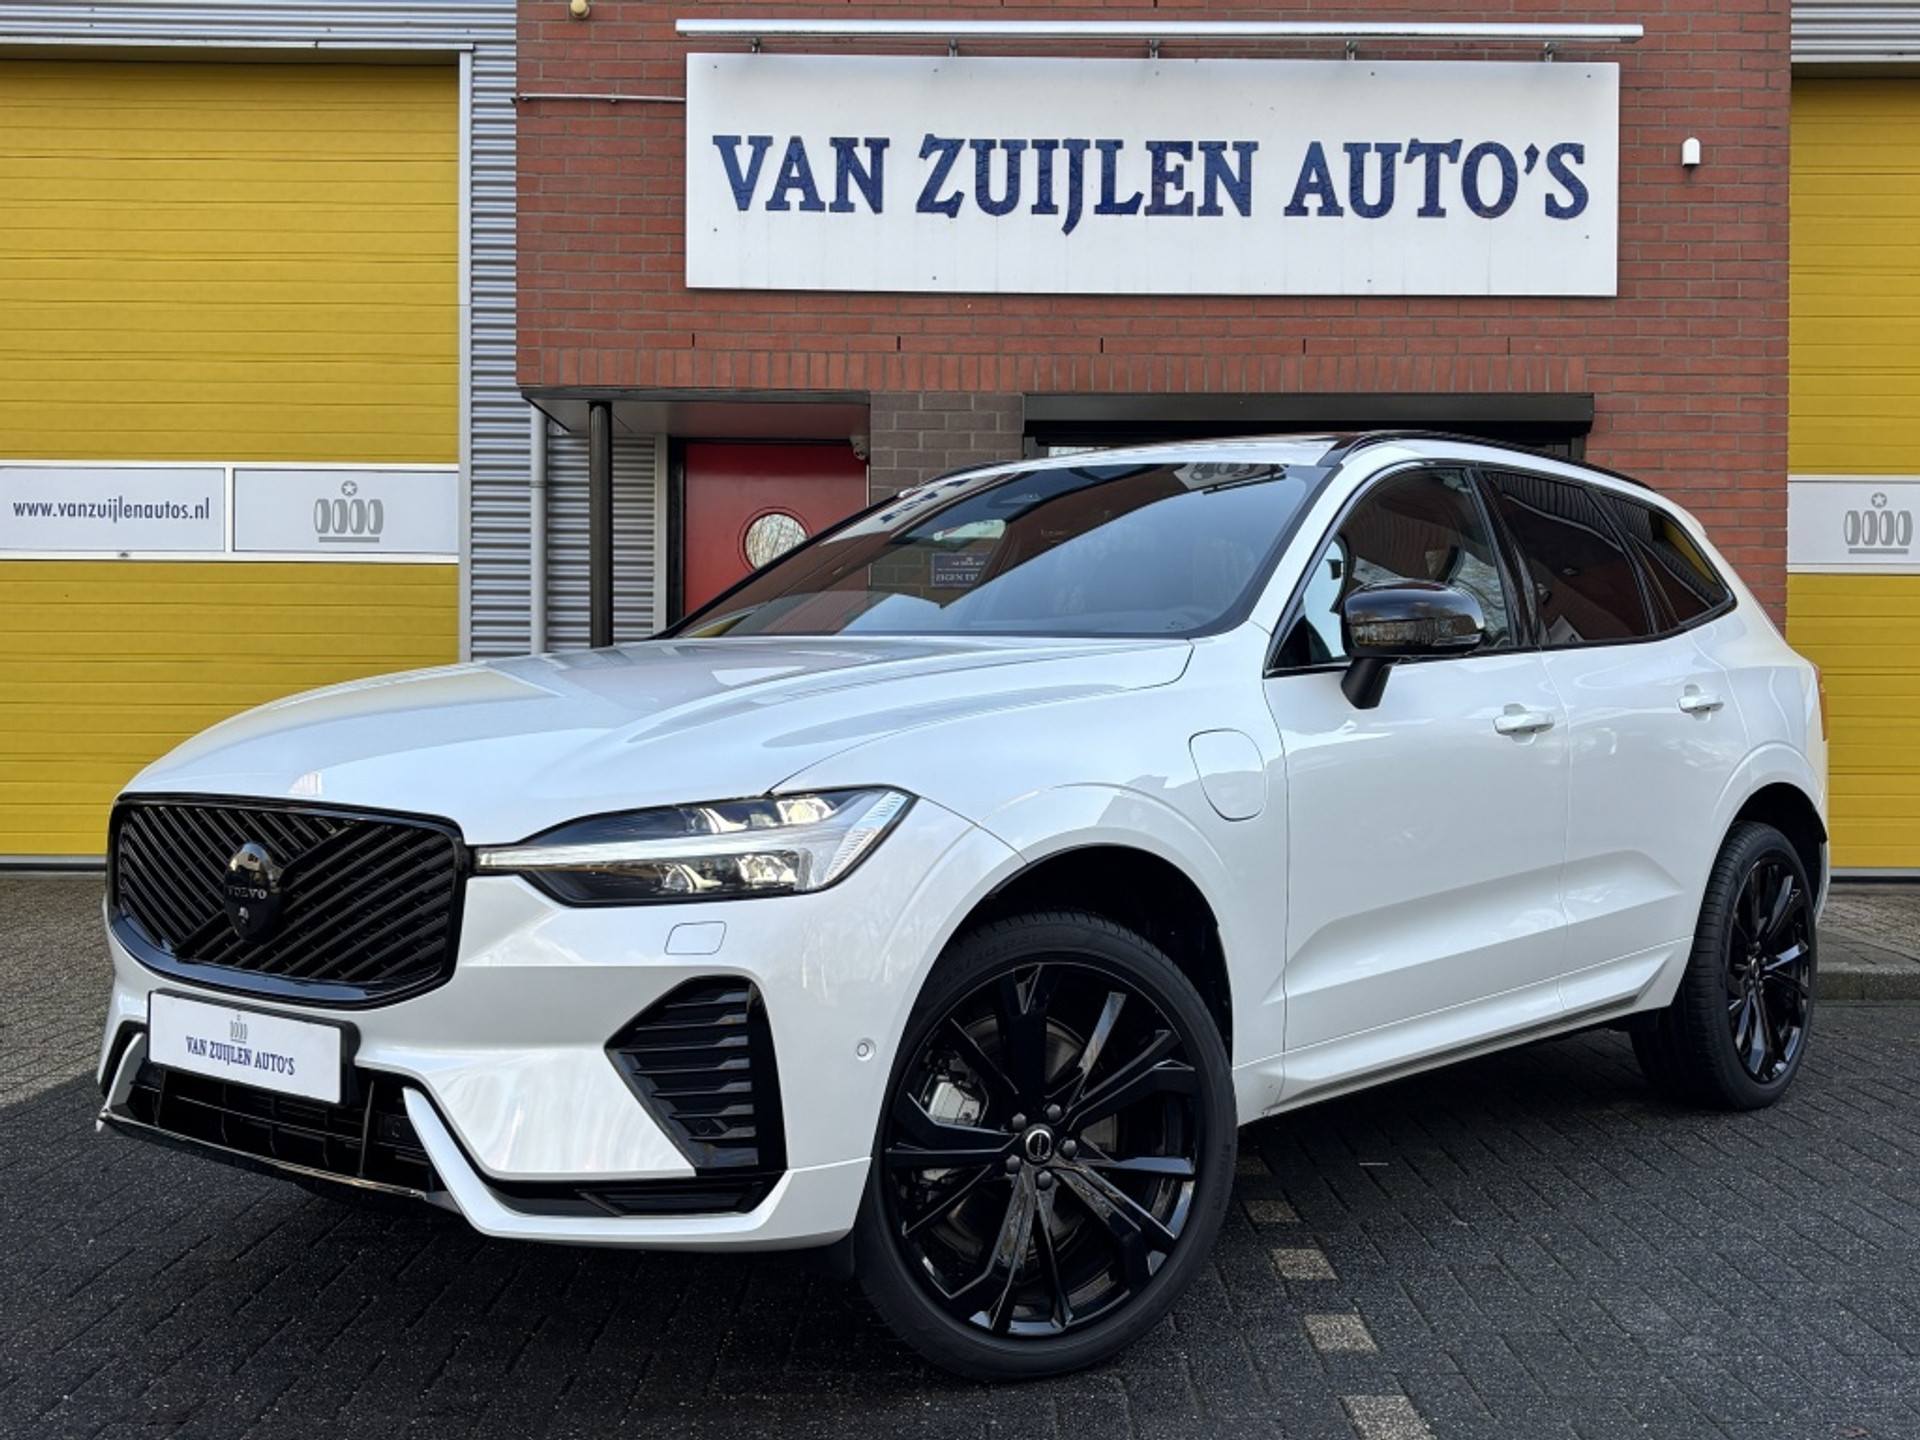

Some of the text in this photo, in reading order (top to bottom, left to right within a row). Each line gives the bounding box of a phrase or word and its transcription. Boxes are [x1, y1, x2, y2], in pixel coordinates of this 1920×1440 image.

[712, 133, 1589, 236] VAN ZUIJLEN AUTO'S
[12, 495, 210, 523] www.vanzuijlenautos.nl
[186, 1036, 295, 1076] VAN ZUIJLEN AUTO'S
